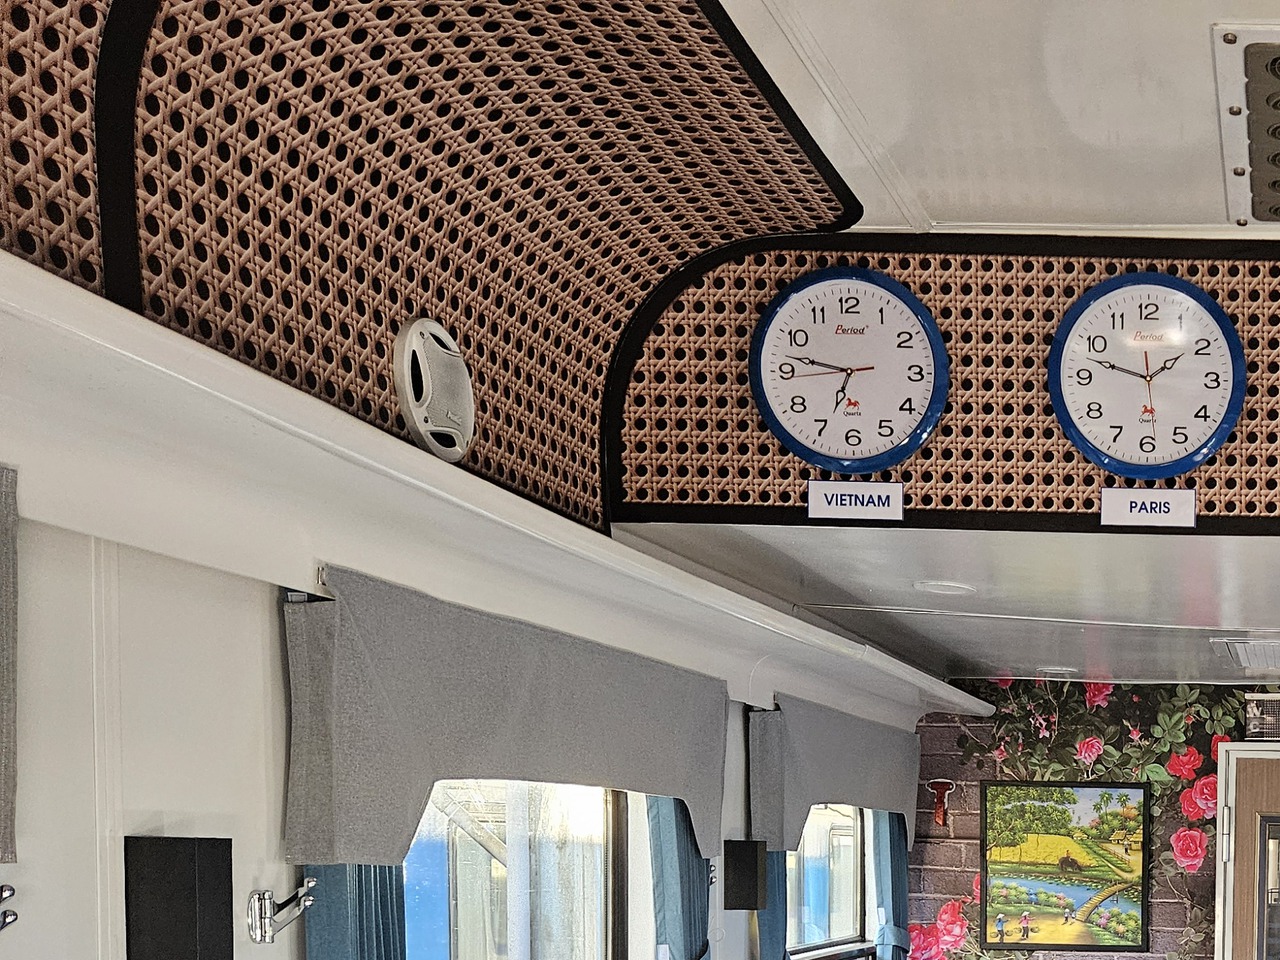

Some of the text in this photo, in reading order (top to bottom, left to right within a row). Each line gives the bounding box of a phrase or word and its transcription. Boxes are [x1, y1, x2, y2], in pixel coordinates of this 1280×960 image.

[839, 297, 860, 314] 12
[1138, 303, 1159, 320] 12
[811, 305, 825, 324] 11
[879, 307, 884, 324] 1
[1110, 312, 1125, 330] 11
[1177, 314, 1183, 331] 1
[788, 329, 809, 347] 10
[835, 324, 866, 335] Period
[896, 332, 913, 348] 2
[1087, 335, 1107, 353] 10
[1195, 339, 1211, 355] 2
[779, 363, 795, 380] 9
[907, 365, 925, 381] 3
[1076, 369, 1093, 386] 9
[1204, 372, 1220, 389] 3
[790, 396, 807, 413] 8
[898, 398, 916, 414] 4
[1086, 402, 1103, 419] 8
[1193, 405, 1210, 422] 4
[814, 419, 827, 436] 7
[877, 420, 894, 437] 5
[1109, 426, 1123, 443] 7
[1172, 427, 1189, 443] 5
[845, 429, 861, 446] 6
[1139, 436, 1156, 452] 6
[824, 493, 890, 508] VIETNAM
[1129, 501, 1171, 514] PARIS
